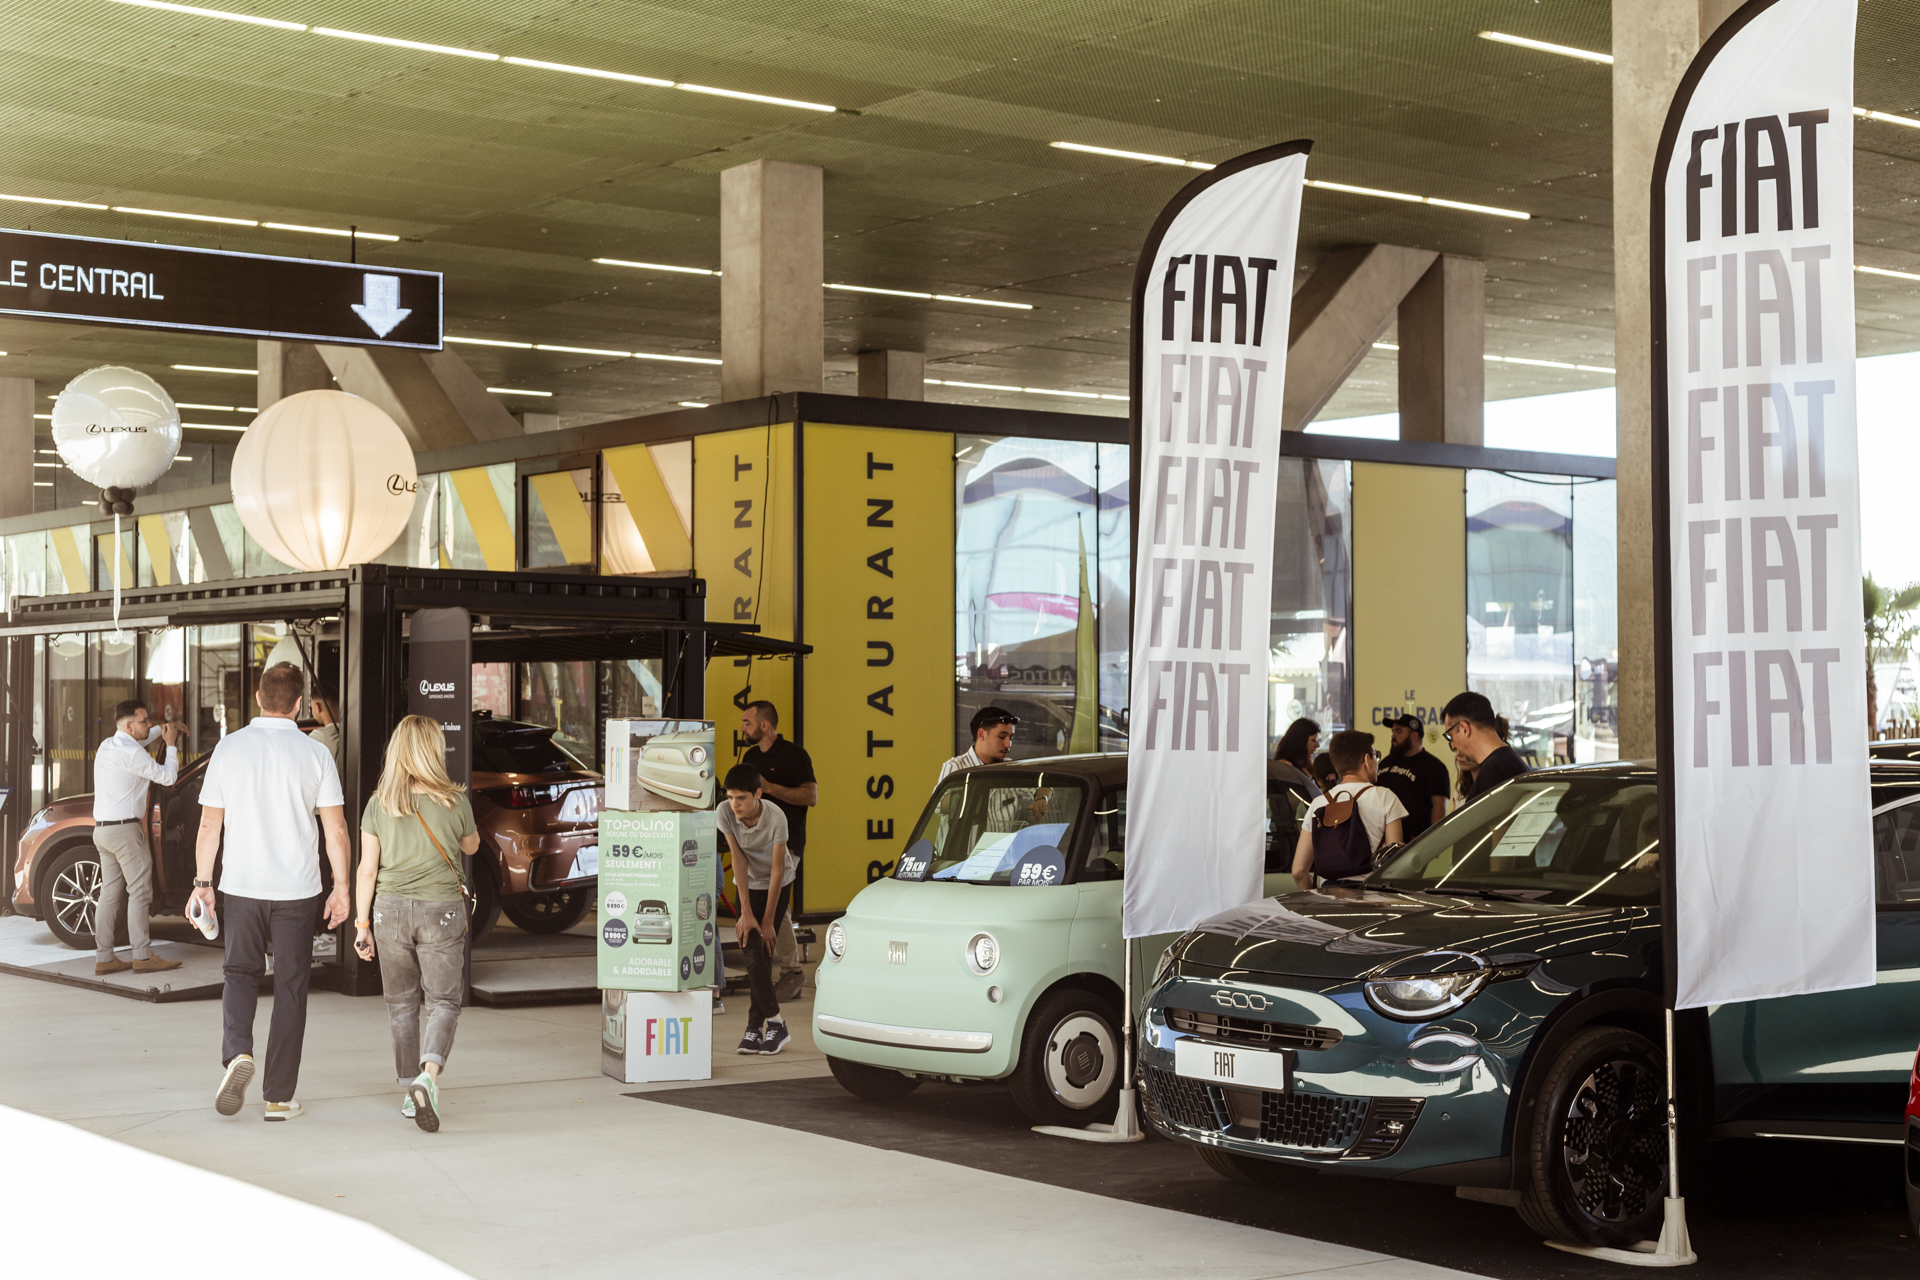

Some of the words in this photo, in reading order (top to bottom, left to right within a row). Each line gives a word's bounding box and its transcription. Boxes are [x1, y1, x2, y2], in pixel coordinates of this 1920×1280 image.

[1686, 108, 1829, 242] FIAT
[39, 262, 165, 301] CENTRAL
[1162, 254, 1278, 347] FIAT
[1686, 244, 1832, 373] FIAT
[1158, 353, 1267, 449] FIAT
[1687, 379, 1835, 504] FIAT
[1153, 456, 1260, 550] FIAT
[1149, 557, 1254, 651] FIAT
[1687, 513, 1838, 636] FIAT
[429, 682, 455, 692] LEXUS
[866, 452, 894, 884] RESTAURANT
[1405, 690, 1415, 700] LE
[1145, 660, 1250, 753] FIAT
[1691, 645, 1840, 769] FIAT
[604, 819, 674, 831] TOPOLINO
[639, 831, 674, 839] DOLCEVITA
[605, 860, 657, 869] SEULEMENT
[613, 967, 620, 975] &
[622, 967, 672, 977] ABORDABLE
[629, 957, 672, 967] ADORABLE
[888, 941, 909, 966] FIAT
[646, 1017, 693, 1056] FIAT
[1213, 1051, 1236, 1078] FIAT
